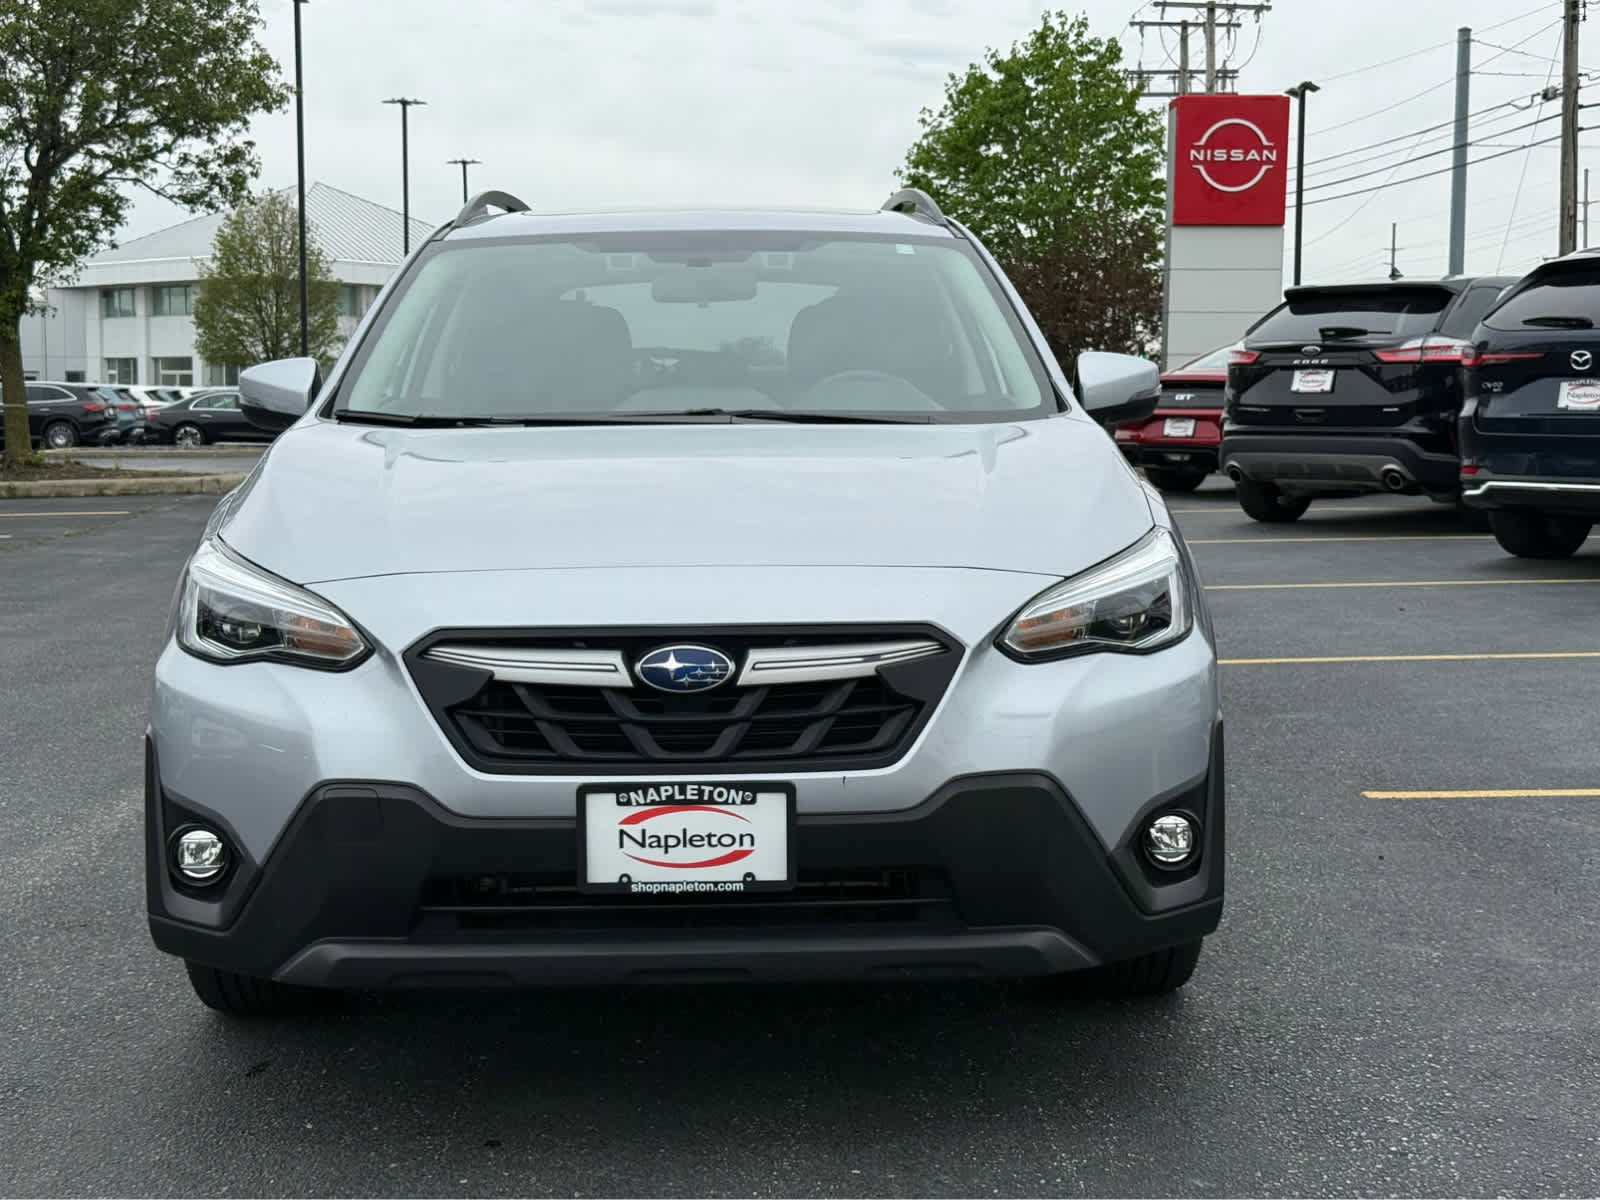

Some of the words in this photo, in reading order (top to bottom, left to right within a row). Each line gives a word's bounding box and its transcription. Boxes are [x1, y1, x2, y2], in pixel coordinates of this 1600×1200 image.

[1190, 149, 1277, 161] NISSAN
[629, 784, 743, 806] NAPLETON
[619, 828, 755, 854] Napleton
[631, 880, 744, 893] shopnapleton.com
